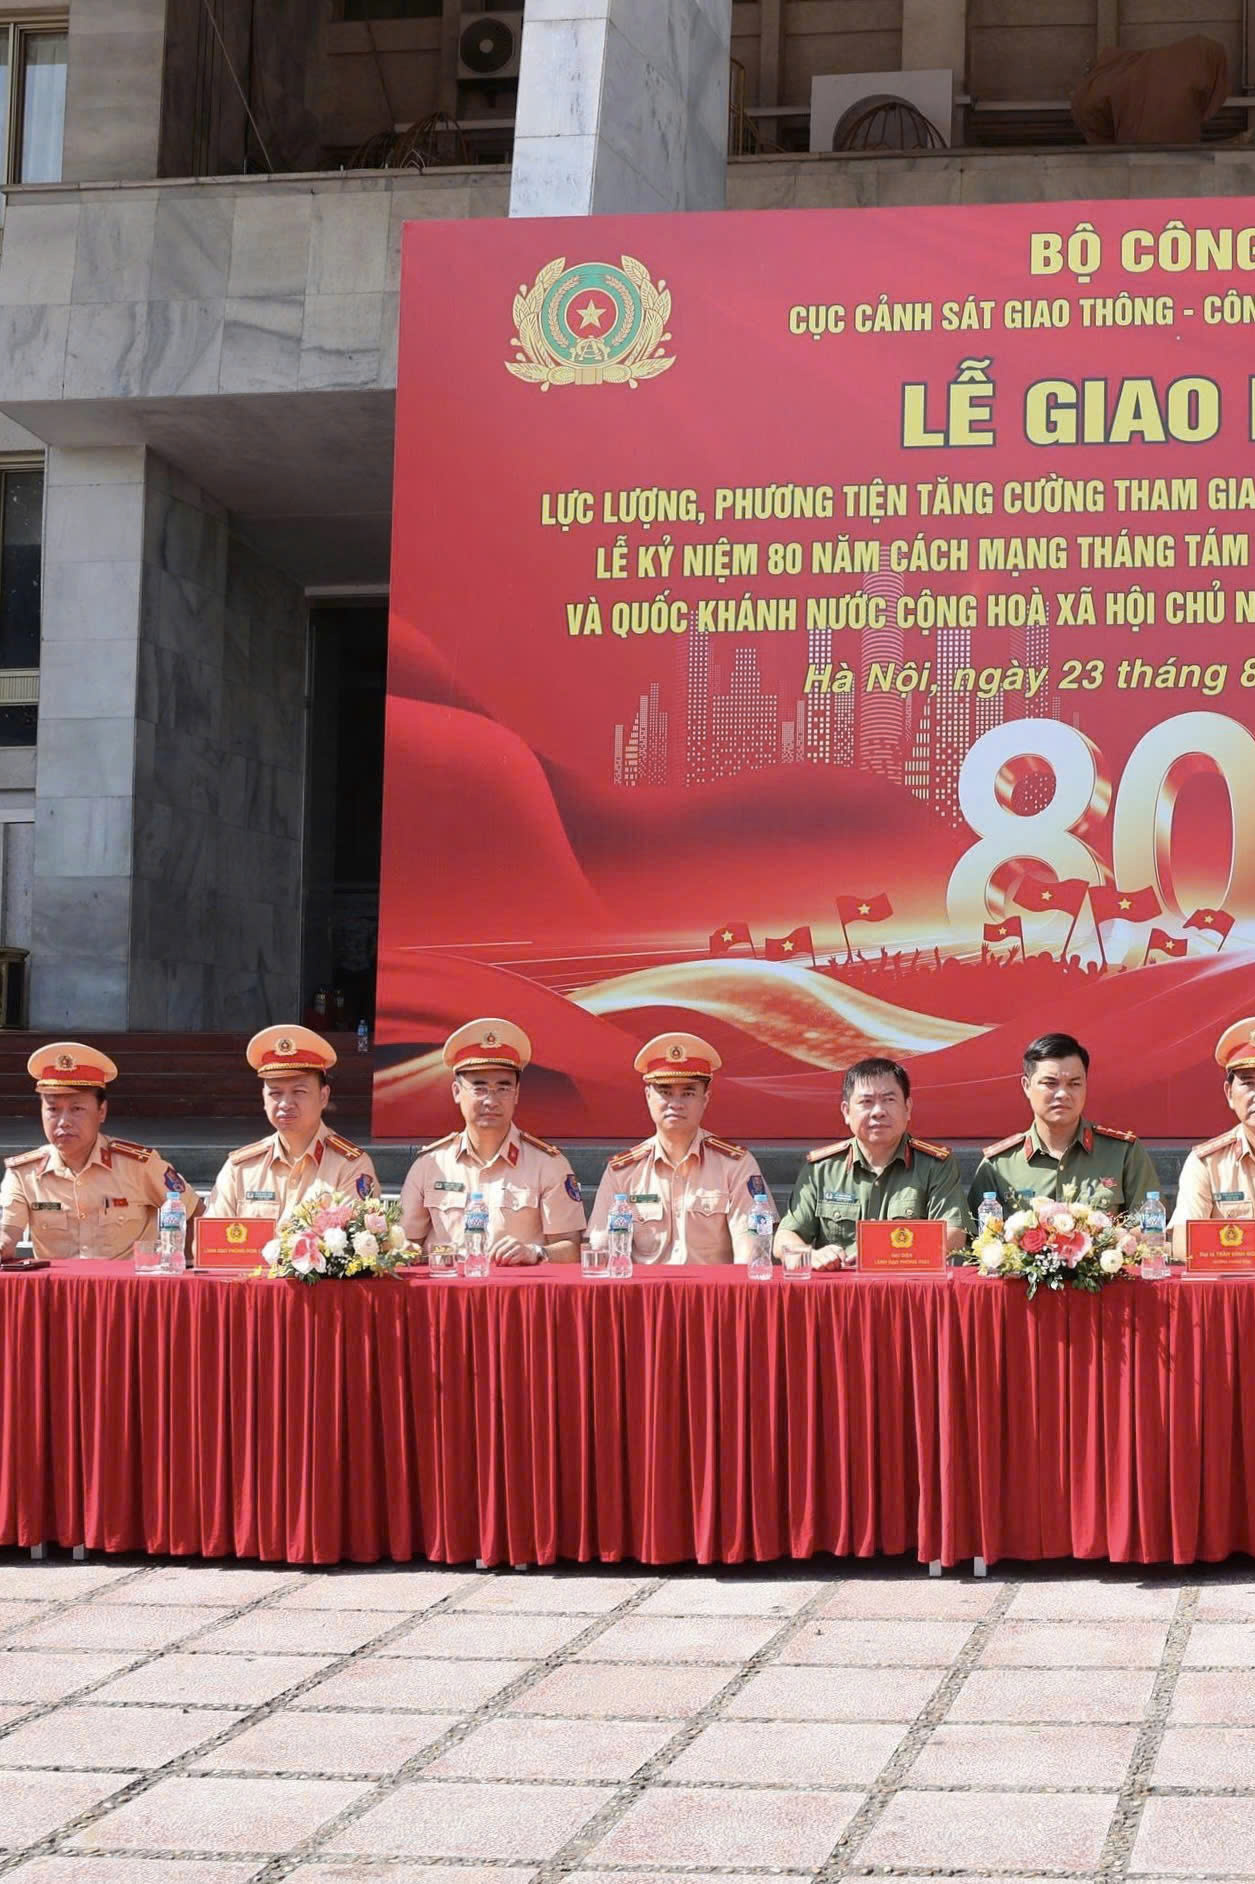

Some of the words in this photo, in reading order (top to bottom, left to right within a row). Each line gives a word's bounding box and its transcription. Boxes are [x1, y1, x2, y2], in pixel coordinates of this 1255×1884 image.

[1030, 221, 1102, 284] BỘ
[788, 303, 847, 339] CỤC
[854, 295, 934, 335] CẢNH
[942, 295, 996, 333] SÁT
[1003, 298, 1073, 329] GIAO
[1079, 292, 1174, 329] THÔNG
[900, 357, 997, 450] LỄ
[1022, 375, 1223, 451] GIAO
[541, 489, 598, 532] LỰC
[602, 487, 706, 529] LƯỢNG,
[714, 484, 836, 521] PHƯƠNG
[842, 479, 909, 524] TIỆN
[916, 476, 995, 516] TĂNG
[1003, 474, 1107, 513] CƯỜNG
[1112, 478, 1198, 513] THAM
[596, 535, 629, 580] LỄ
[637, 535, 675, 578] KỶ
[682, 536, 759, 584] NIỆM
[767, 542, 804, 576] 80
[811, 533, 883, 576] NĂM
[888, 532, 970, 574] CÁCH
[978, 536, 1070, 577] MẠNG
[1077, 531, 1176, 569] THÁNG
[1183, 528, 1249, 569] TÁM
[566, 596, 604, 636] VÀ
[611, 591, 689, 638] QUỐC
[695, 595, 798, 633] KHÁNH
[805, 591, 889, 632] NƯỚC
[895, 588, 978, 636] CỘNG
[986, 587, 1048, 629] HOÀ
[1056, 586, 1097, 626] XÃ
[1105, 584, 1156, 633] HỘI
[1165, 581, 1228, 625] CHỦ
[802, 663, 854, 696] Hà
[865, 660, 940, 697] Nội,
[951, 660, 1049, 701] ngày
[1058, 659, 1105, 690] 23
[1117, 656, 1228, 697] tháng
